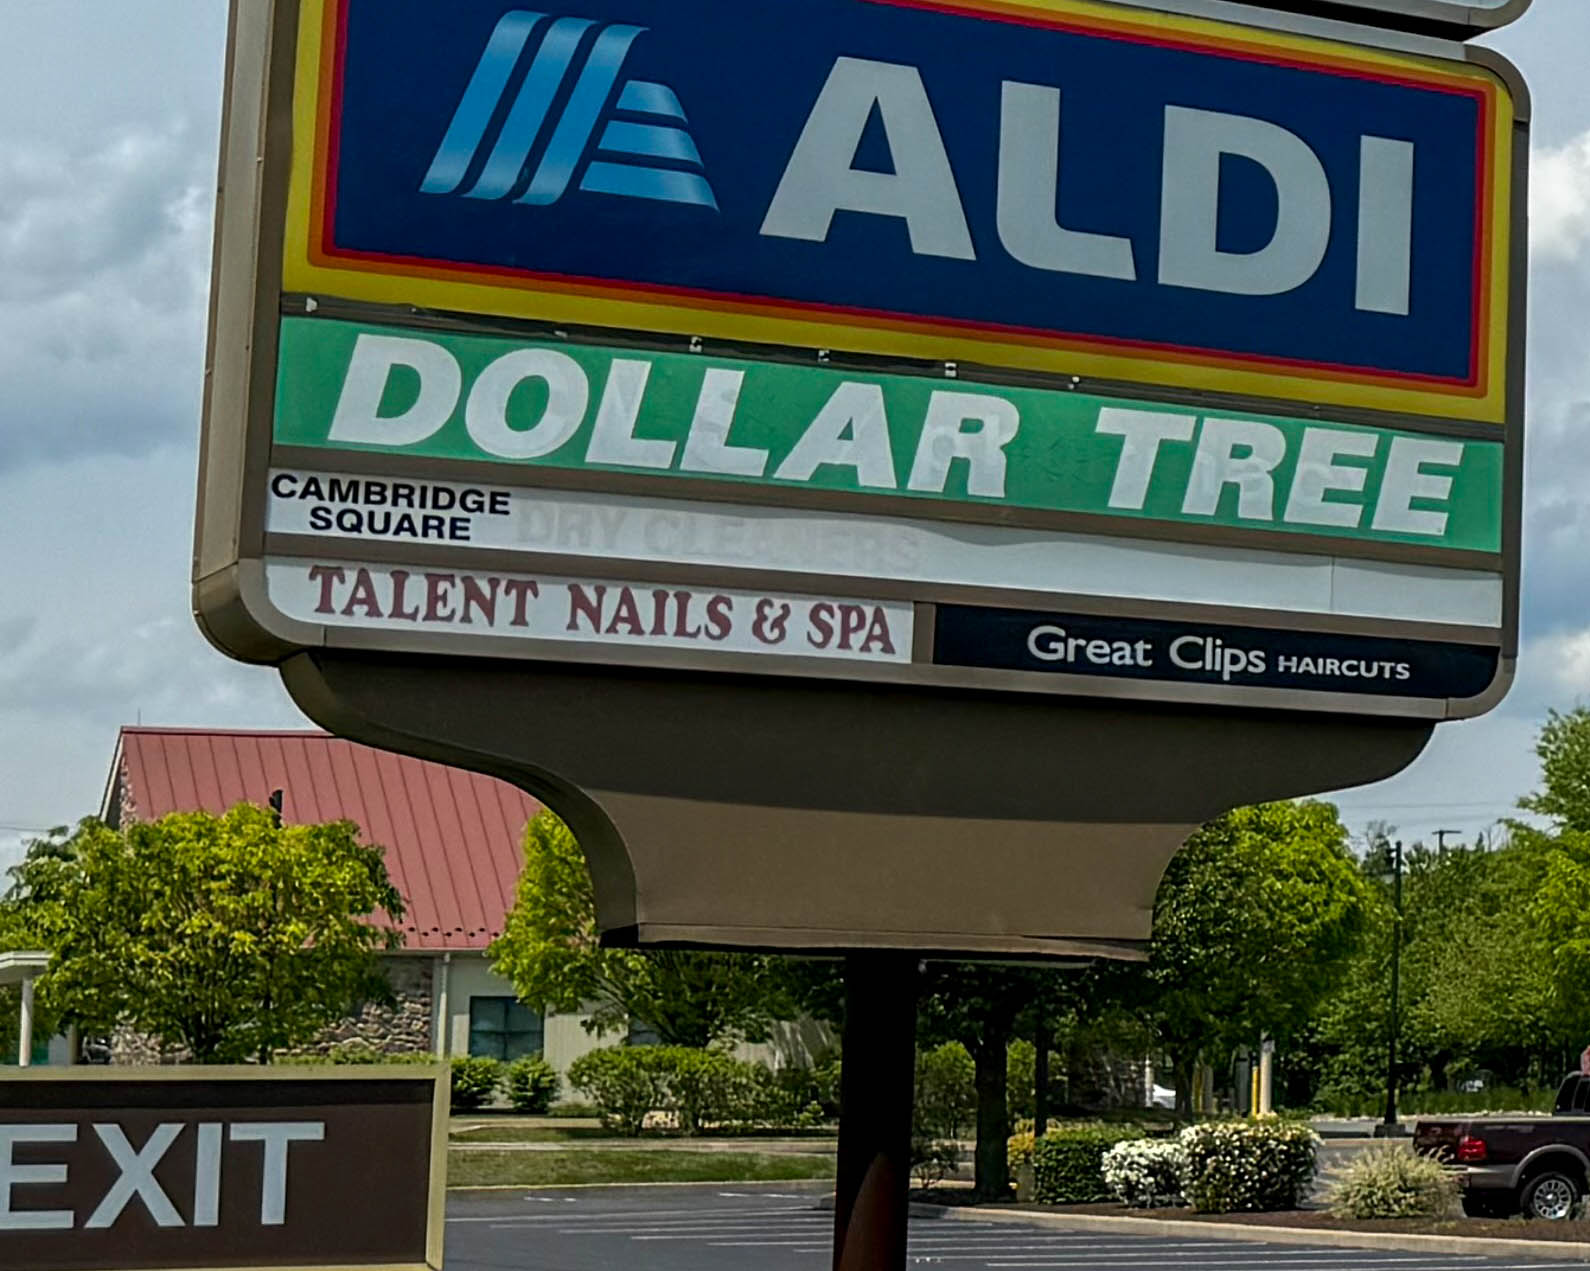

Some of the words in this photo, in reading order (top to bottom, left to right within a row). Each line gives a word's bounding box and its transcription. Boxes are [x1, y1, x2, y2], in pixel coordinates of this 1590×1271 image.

[760, 55, 1414, 316] ALDI
[326, 333, 1020, 498] DOLLAR
[1094, 405, 1466, 536] TREE
[271, 474, 512, 515] CAMBRIDGE
[309, 506, 471, 542] SQUARE
[309, 565, 539, 627] TALENT
[566, 583, 734, 641] NAILS
[751, 598, 791, 645] &
[807, 603, 897, 655] SPA
[1027, 625, 1153, 669] Great
[1169, 635, 1266, 681] Clips
[1278, 655, 1411, 680] HAIRCUTS
[0, 1122, 325, 1230] EXIT
